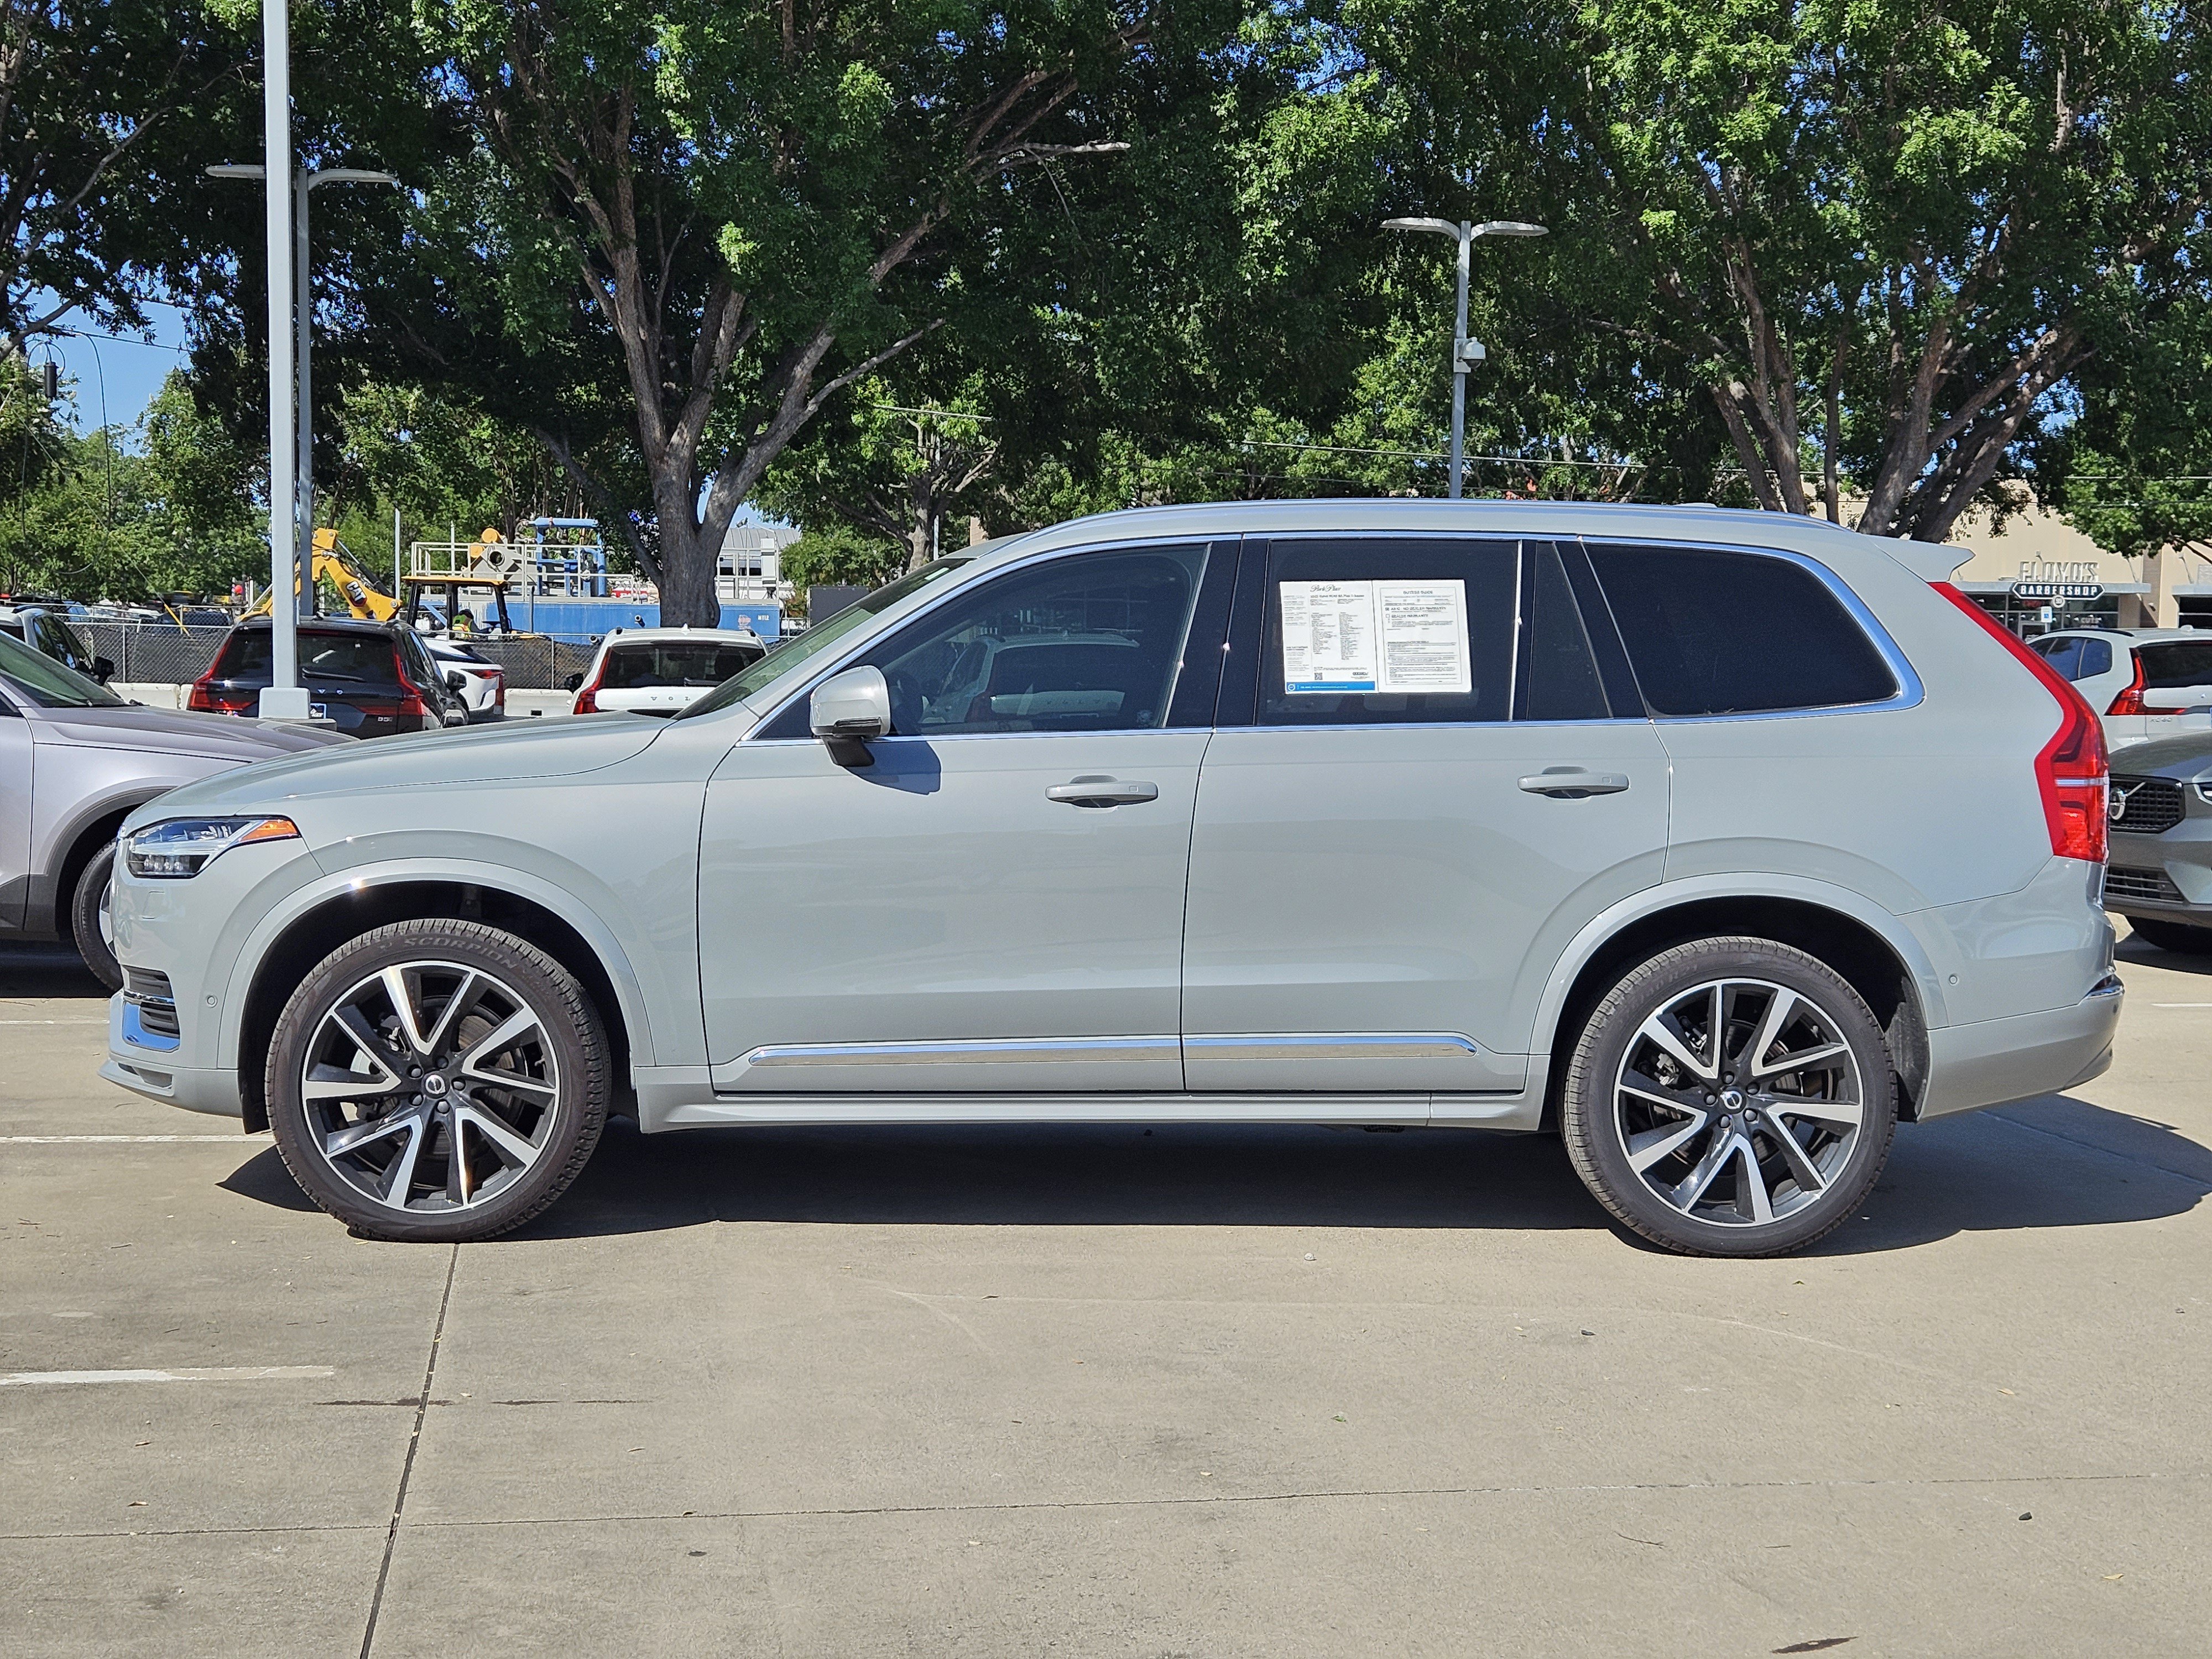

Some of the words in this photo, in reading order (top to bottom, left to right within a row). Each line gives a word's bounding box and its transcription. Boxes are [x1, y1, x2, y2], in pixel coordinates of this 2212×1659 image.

[2018, 561, 2099, 582] FLOYD'S
[346, 581, 367, 602] CAT
[2020, 585, 2098, 596] BARBERSHOP
[404, 937, 519, 969] SCORPION
